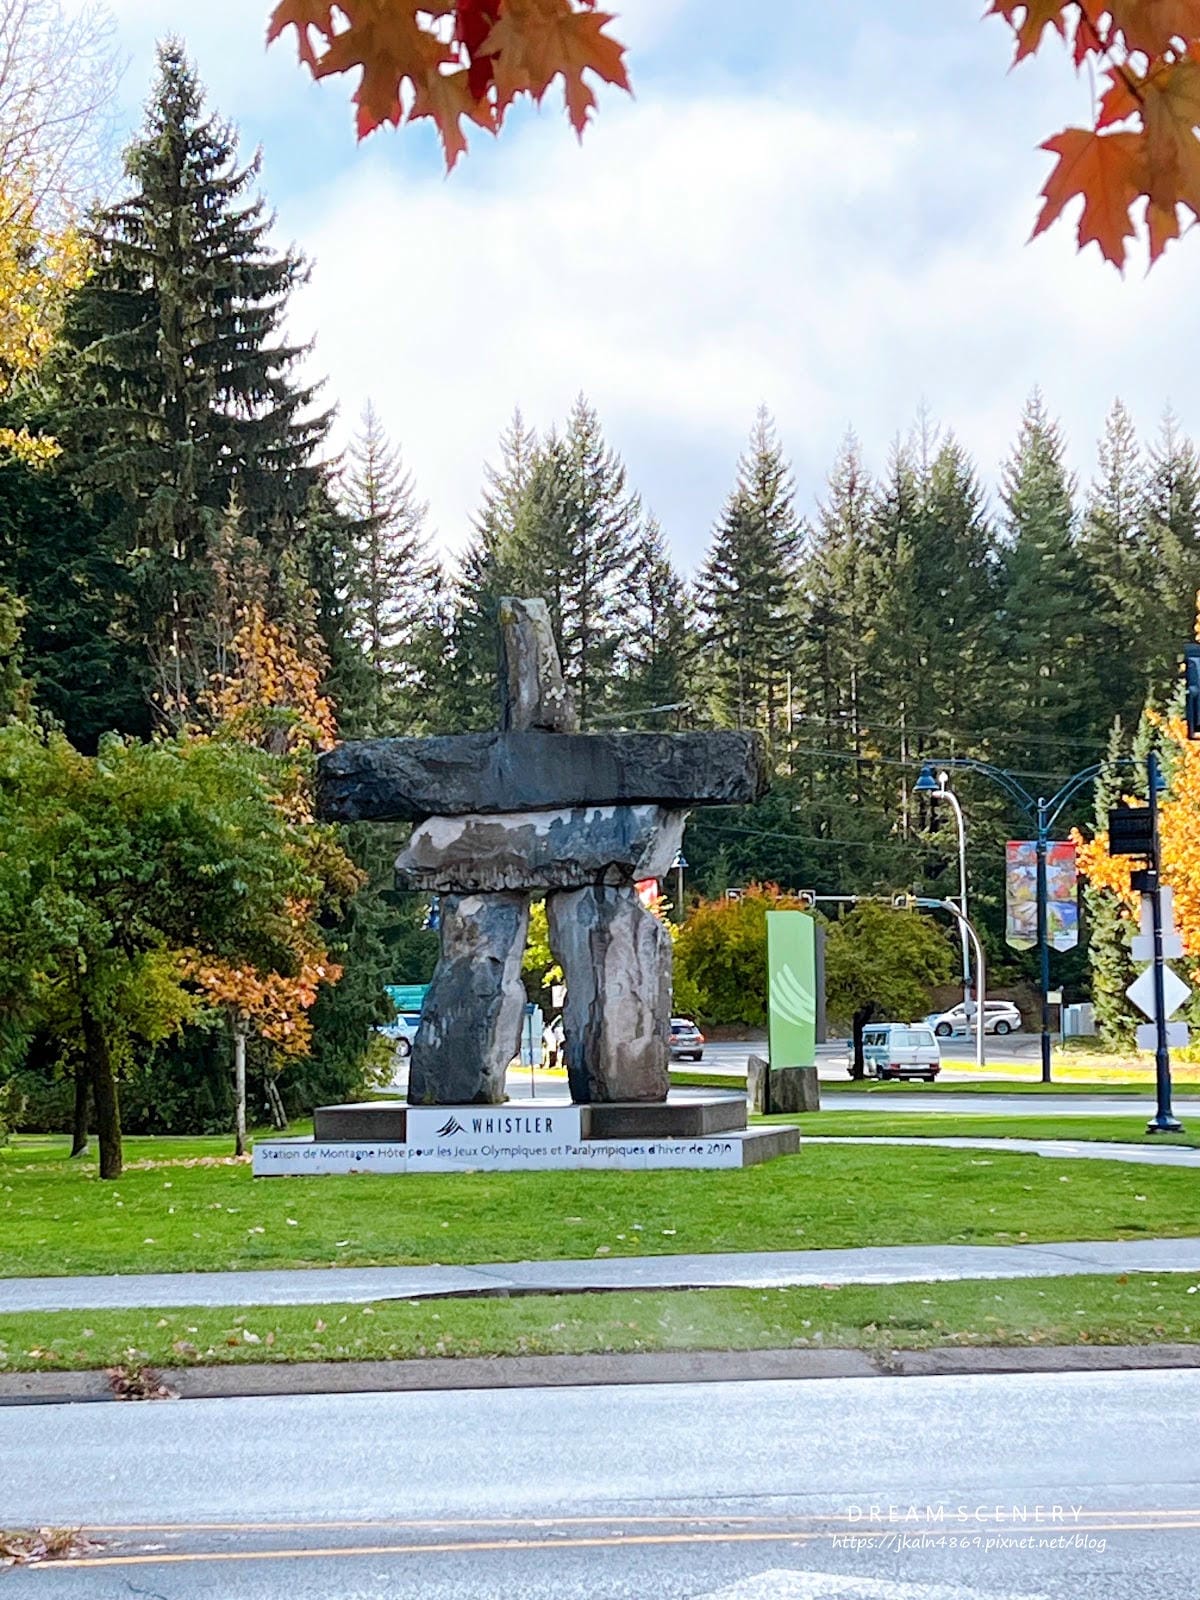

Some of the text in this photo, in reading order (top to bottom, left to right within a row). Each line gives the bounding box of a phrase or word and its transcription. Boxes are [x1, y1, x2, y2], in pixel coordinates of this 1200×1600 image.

[472, 1117, 553, 1133] WHISTLER
[262, 1148, 300, 1160] Station
[303, 1148, 316, 1159] de
[320, 1148, 375, 1161] Montagne
[378, 1147, 406, 1159] Hôte
[408, 1147, 433, 1159] pour
[437, 1145, 451, 1157] les
[454, 1146, 478, 1157] Jeux
[481, 1144, 547, 1159] Olympiques
[550, 1145, 561, 1155] et
[565, 1144, 645, 1158] Paralympiques
[689, 1142, 704, 1155] de
